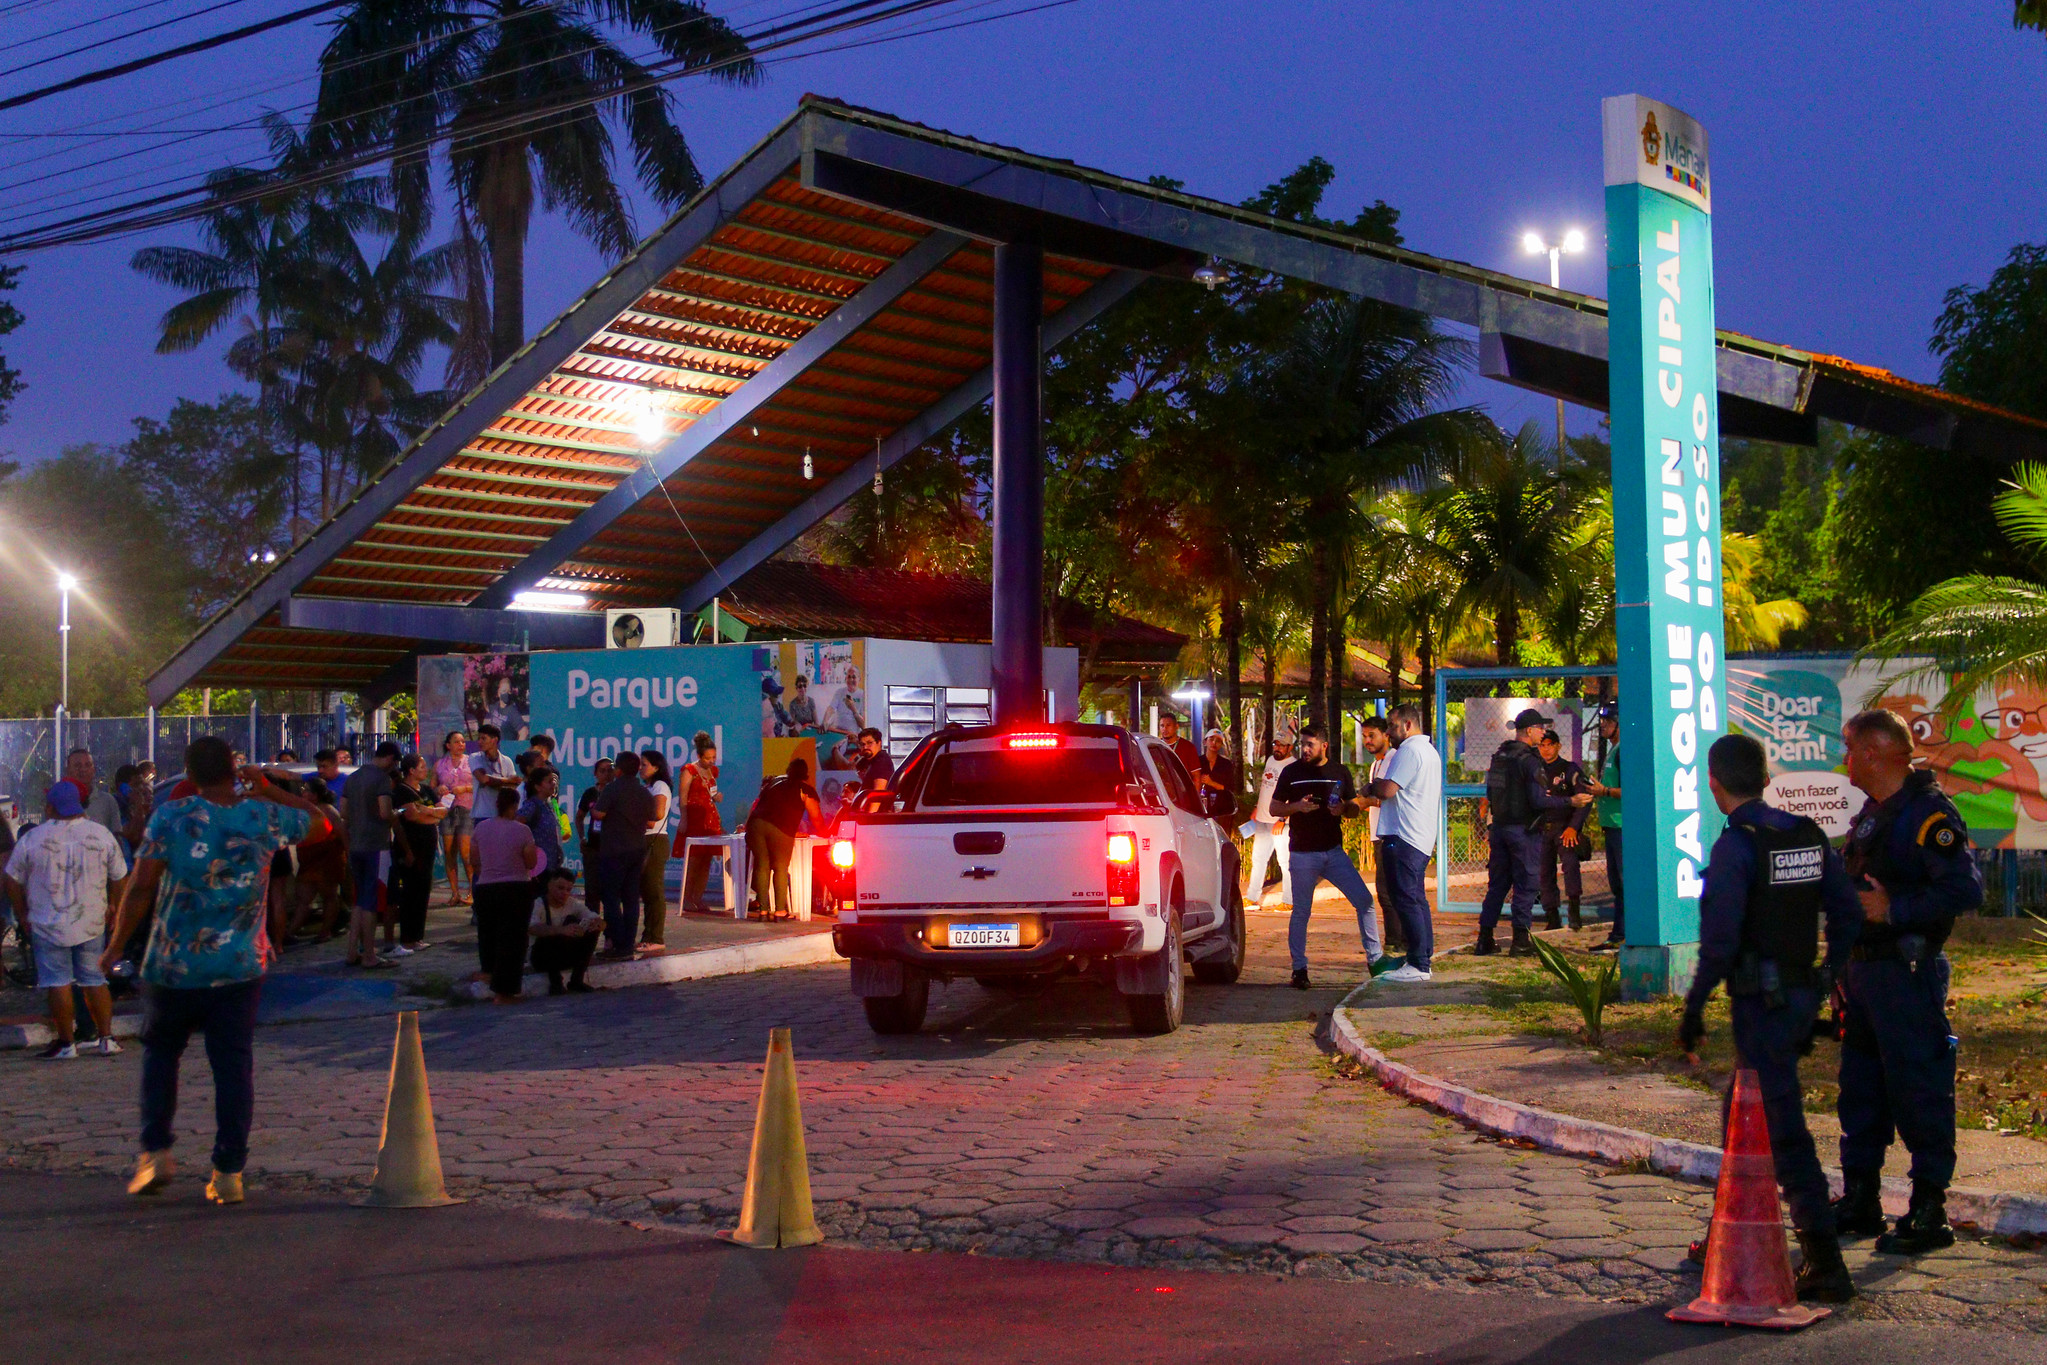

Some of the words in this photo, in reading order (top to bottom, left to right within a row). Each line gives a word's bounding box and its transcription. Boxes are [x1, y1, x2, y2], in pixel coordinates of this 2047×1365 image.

[1692, 392, 1714, 607] IDOSO
[567, 669, 698, 718] Parque
[1698, 632, 1717, 731] DO
[1762, 691, 1822, 717] Doar
[1771, 715, 1810, 740] faz
[1667, 624, 1704, 898] PARQUE
[1764, 736, 1827, 761] bem!
[1776, 787, 1805, 798] Vem
[1808, 785, 1839, 796] fazer
[1788, 800, 1817, 812] bem
[1819, 797, 1849, 810] você
[1775, 850, 1822, 868] GUARDA
[1775, 865, 1822, 880] MUNICIPAL
[860, 892, 880, 900] S10
